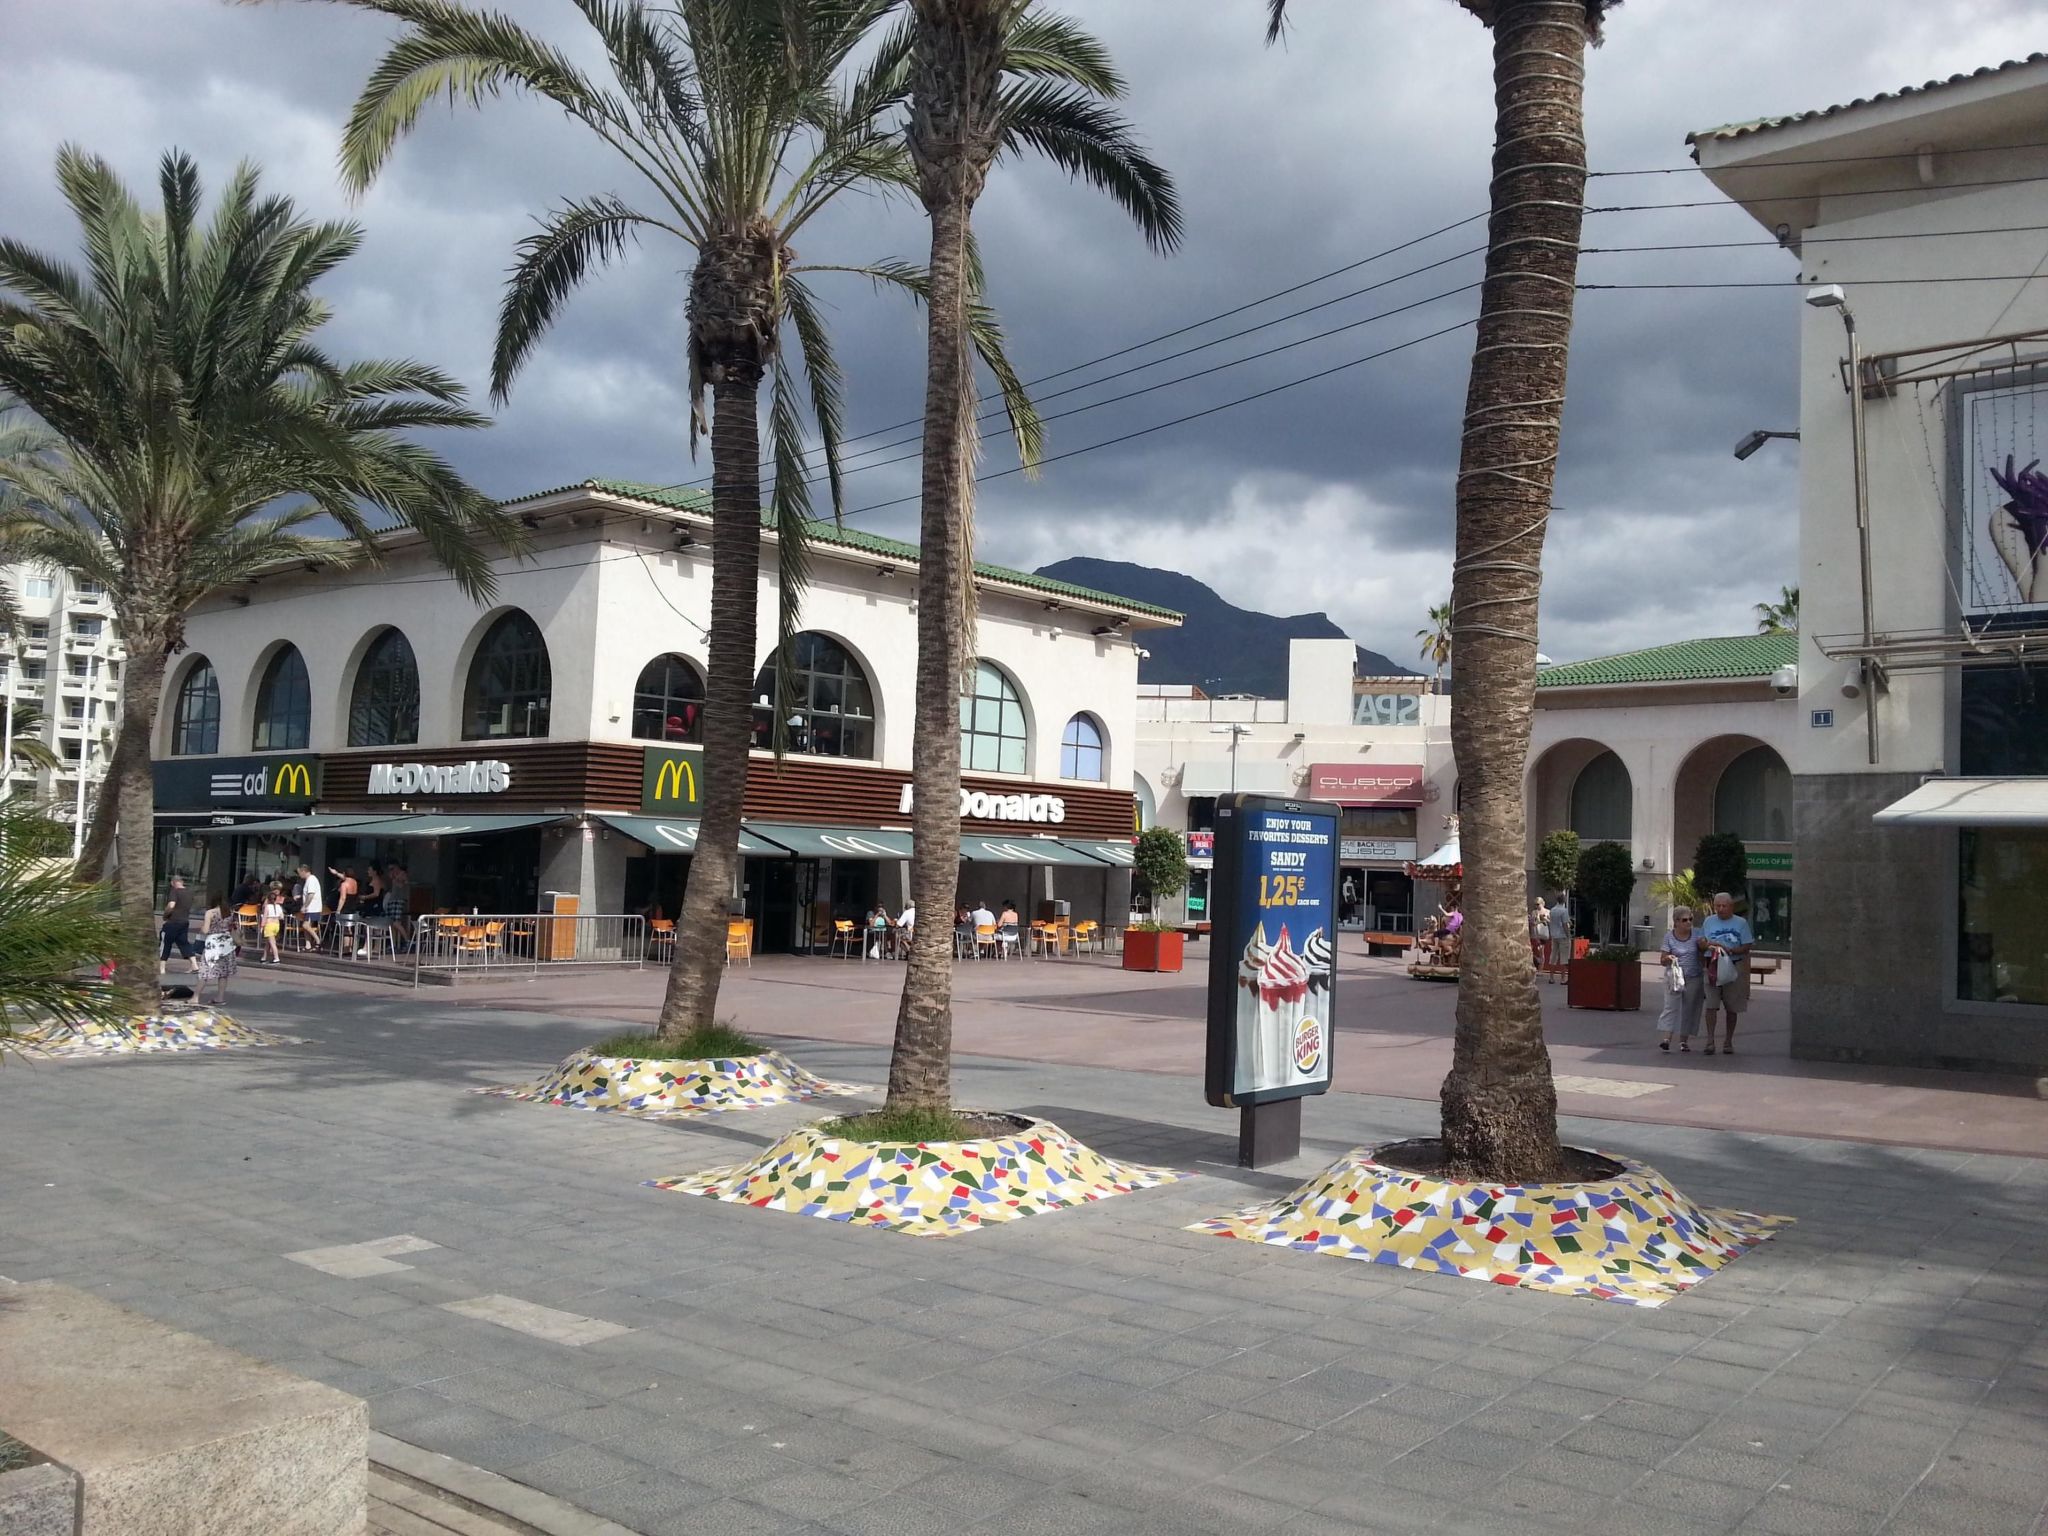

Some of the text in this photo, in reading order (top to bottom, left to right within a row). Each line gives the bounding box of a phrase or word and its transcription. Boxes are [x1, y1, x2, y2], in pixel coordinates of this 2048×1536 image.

[368, 760, 510, 794] McDonald's
[899, 784, 1065, 823] onald's
[1266, 818, 1311, 831] ENJOY YOUR
[1249, 830, 1328, 844] FAVORITES DESSERTS
[1270, 851, 1307, 866] SANDY
[1296, 1026, 1319, 1048] BURGER
[1296, 1036, 1320, 1062] KING
